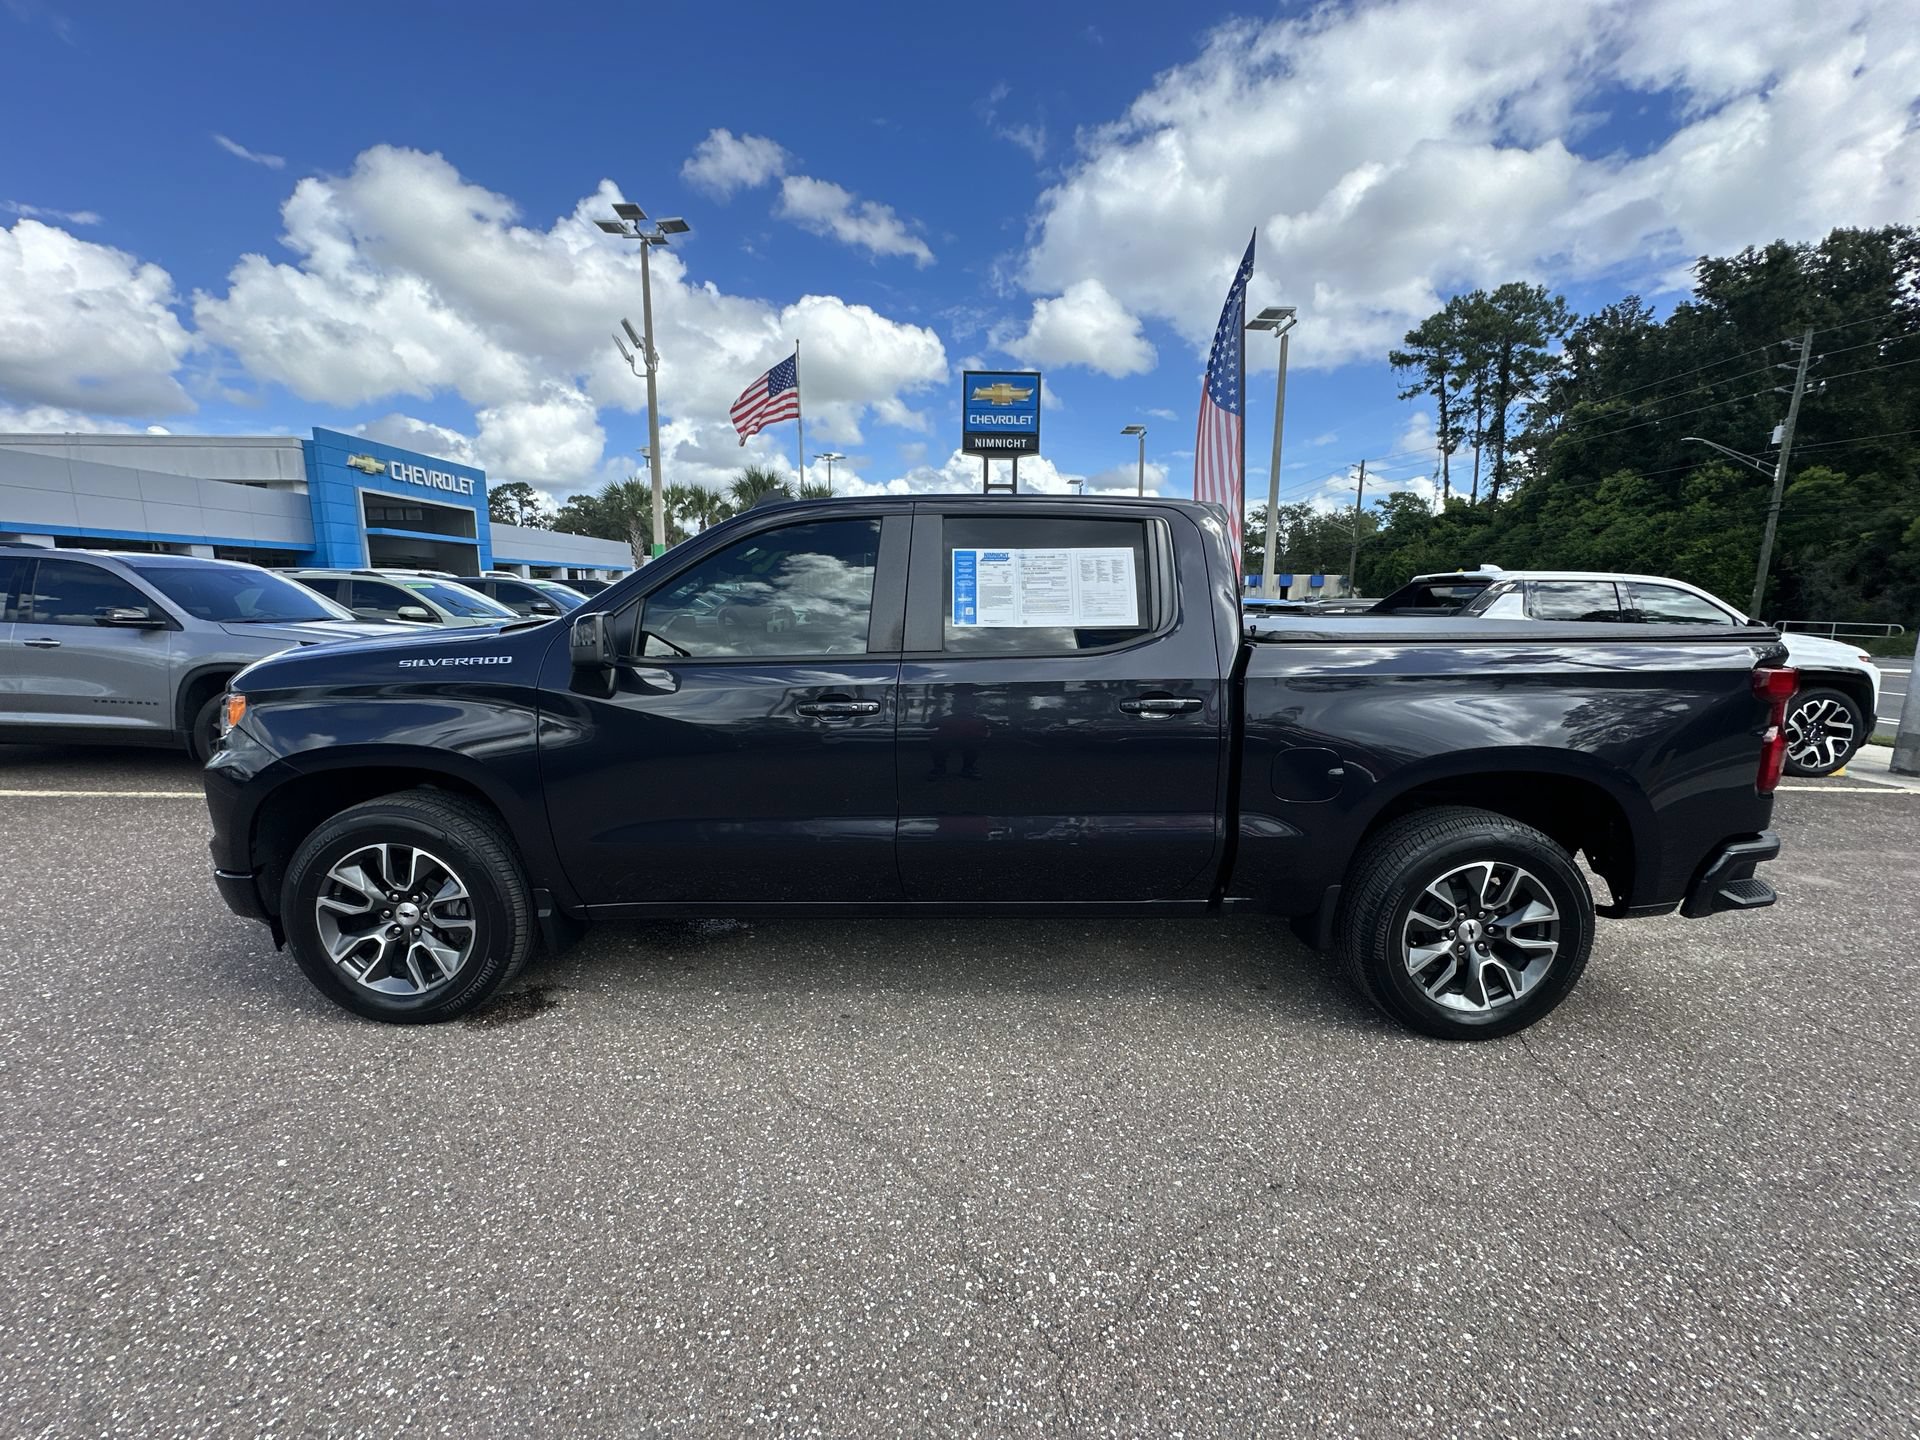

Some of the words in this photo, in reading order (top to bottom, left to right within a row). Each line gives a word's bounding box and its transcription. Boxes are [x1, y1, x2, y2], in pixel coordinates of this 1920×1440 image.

[970, 415, 1033, 425] CHEVROLET
[974, 438, 1027, 448] NIMNICHT
[390, 460, 475, 496] CHEVROLET
[398, 655, 513, 668] SILVERADO
[1373, 885, 1406, 960] BRIDGESTONE
[439, 957, 499, 1015] BRIDGESTONE
